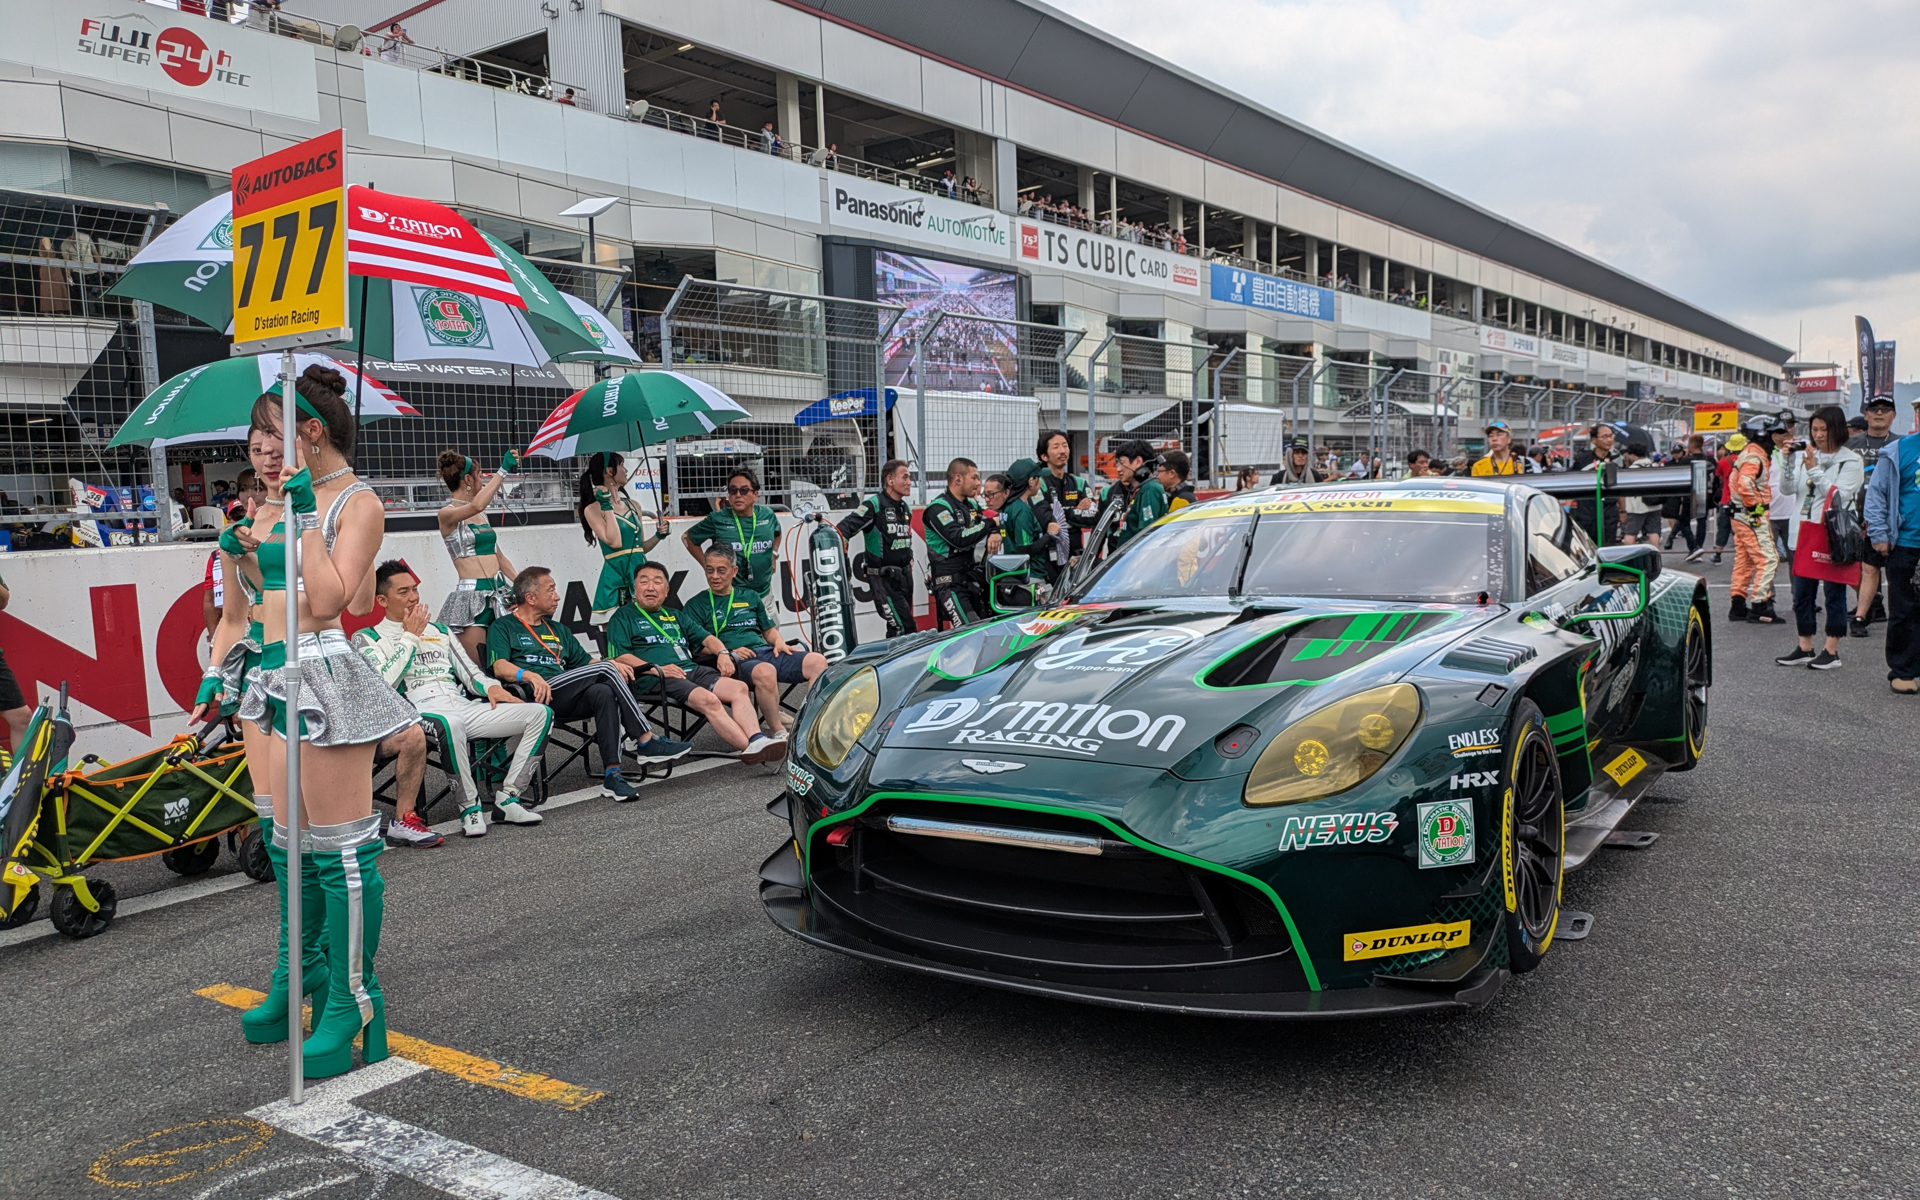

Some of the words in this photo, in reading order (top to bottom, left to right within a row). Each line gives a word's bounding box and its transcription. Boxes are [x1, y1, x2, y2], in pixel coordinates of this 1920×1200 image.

[81, 18, 152, 49] FUJI
[77, 38, 151, 66] SUPER
[215, 68, 252, 88] TEC
[251, 150, 338, 194] AUTOBACS
[358, 206, 462, 239] D'STATION
[835, 188, 922, 227] Panasonic
[927, 215, 1005, 246] AUTOMOTIVE
[238, 200, 338, 309] 777
[1044, 229, 1069, 265] TS
[1076, 238, 1136, 278] CUBIC
[1140, 258, 1168, 279] CARD
[254, 312, 289, 331] D'station
[290, 308, 320, 325] Racing
[1861, 355, 1870, 404] SUBARU
[829, 397, 864, 412] KeePer
[1710, 413, 1722, 426] 2
[87, 491, 102, 502] 38
[1320, 500, 1393, 510] seven
[1402, 491, 1479, 500] NEXUS
[812, 546, 847, 667] D'STATION
[1065, 663, 1142, 674] ampersand
[903, 695, 1187, 753] D'STATION
[948, 729, 1104, 753] RACING
[1447, 727, 1500, 750] ENDLESS
[1616, 755, 1637, 777] DUNLOP
[1450, 770, 1500, 790] HRX
[1279, 812, 1399, 851] NEXUS
[1432, 835, 1464, 849] STATION
[1505, 793, 1514, 894] DUNLOP
[1369, 929, 1463, 951] DUNLOP
